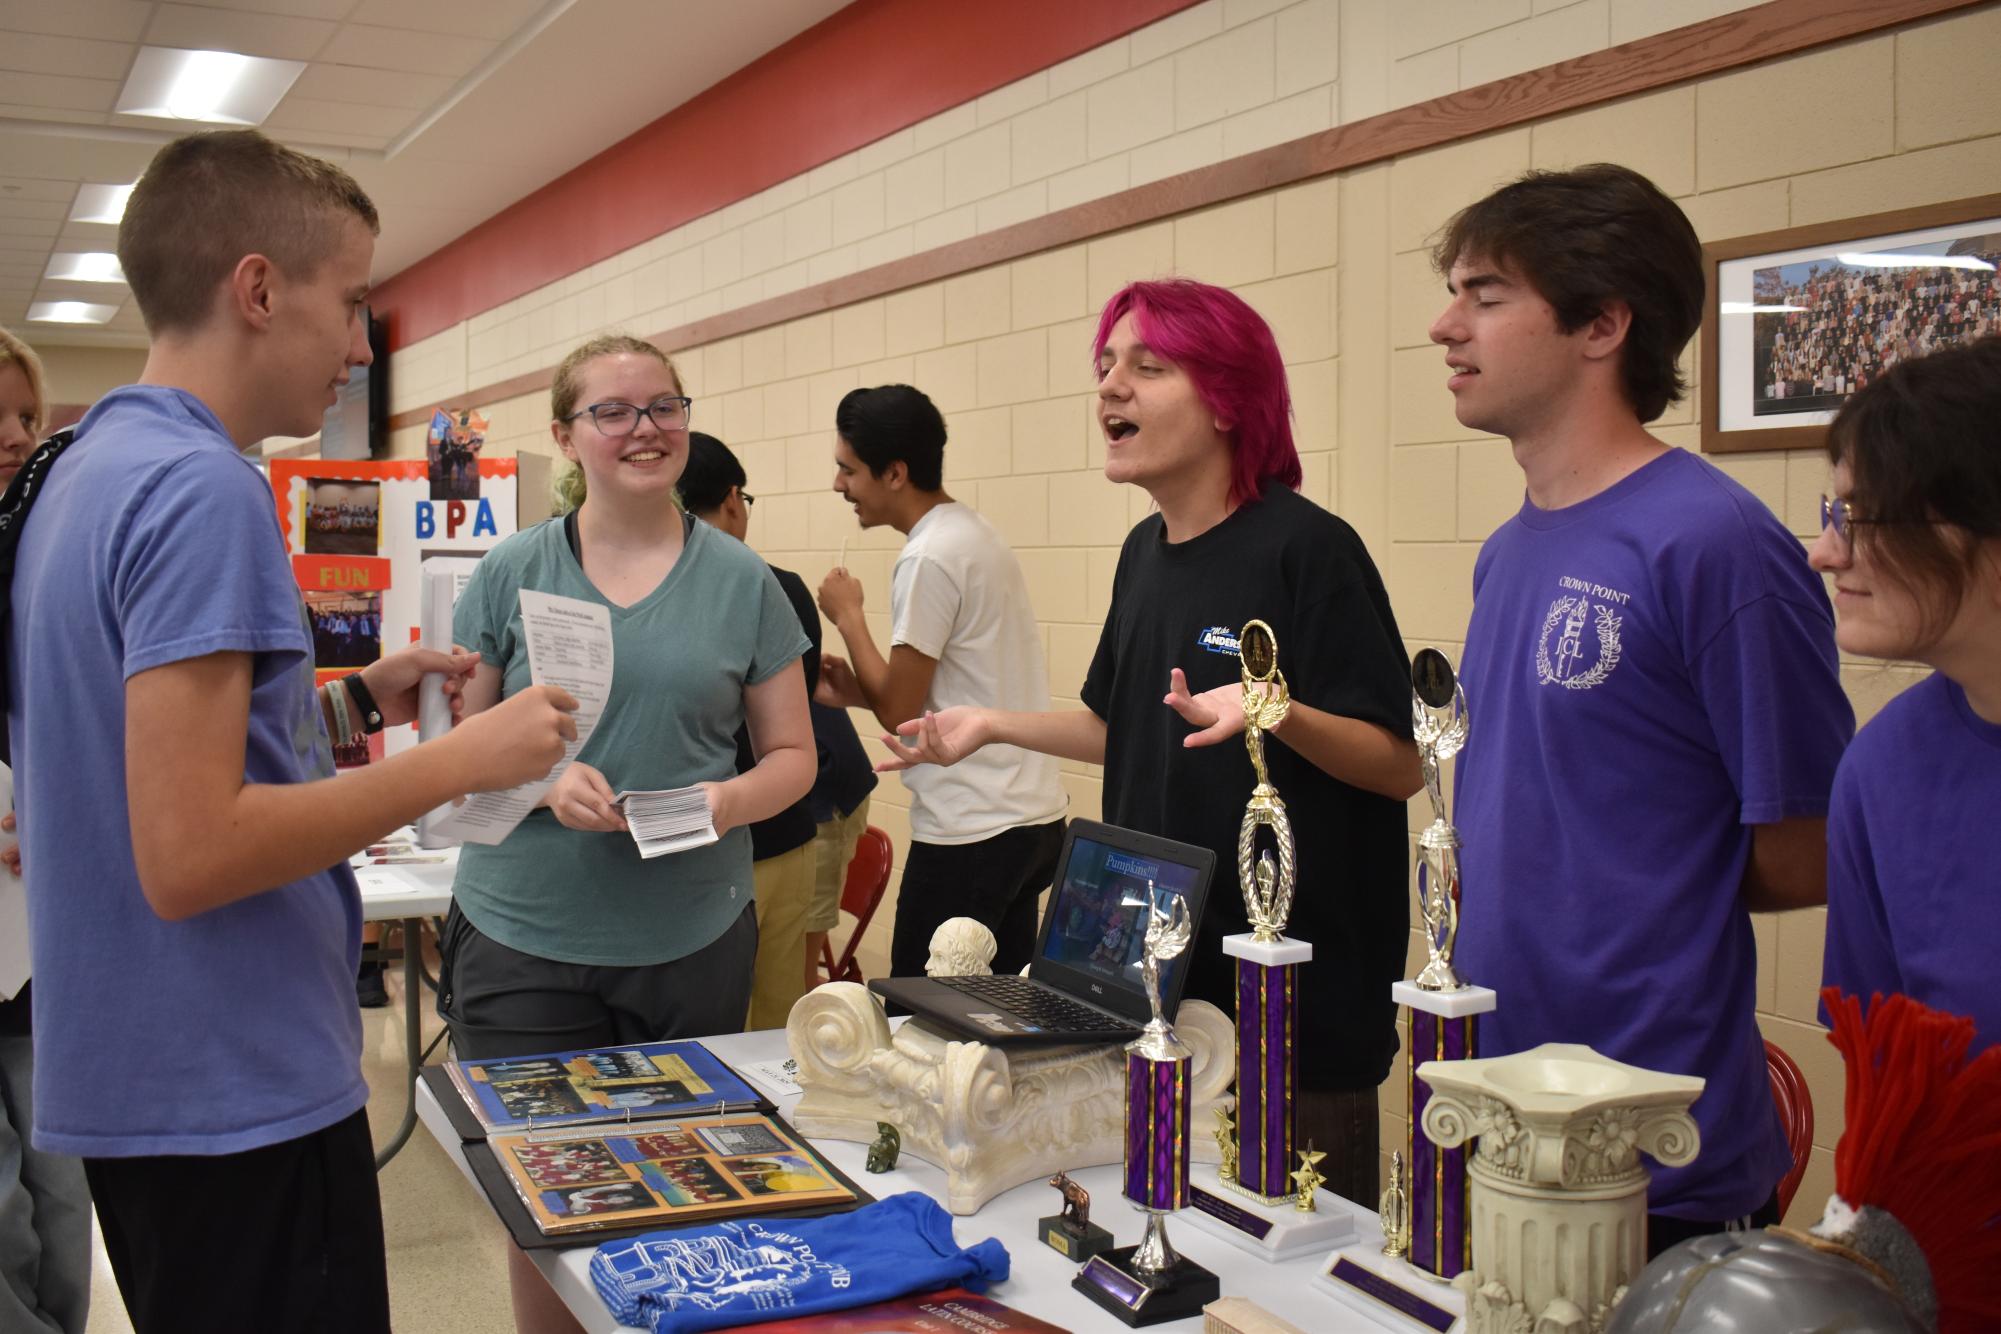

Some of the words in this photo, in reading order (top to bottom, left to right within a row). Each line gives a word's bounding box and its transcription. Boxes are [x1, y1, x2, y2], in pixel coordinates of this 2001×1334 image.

[416, 497, 498, 539] BPA
[319, 567, 370, 588] FUN
[1559, 576, 1592, 594] CROWN
[1591, 584, 1631, 606] POINT
[1203, 632, 1242, 649] ANDERS
[1555, 636, 1584, 659] JCL
[1091, 983, 1104, 995] DELL
[919, 1303, 954, 1320] LATIN
[944, 1302, 1010, 1330] CAMBRIDGE
